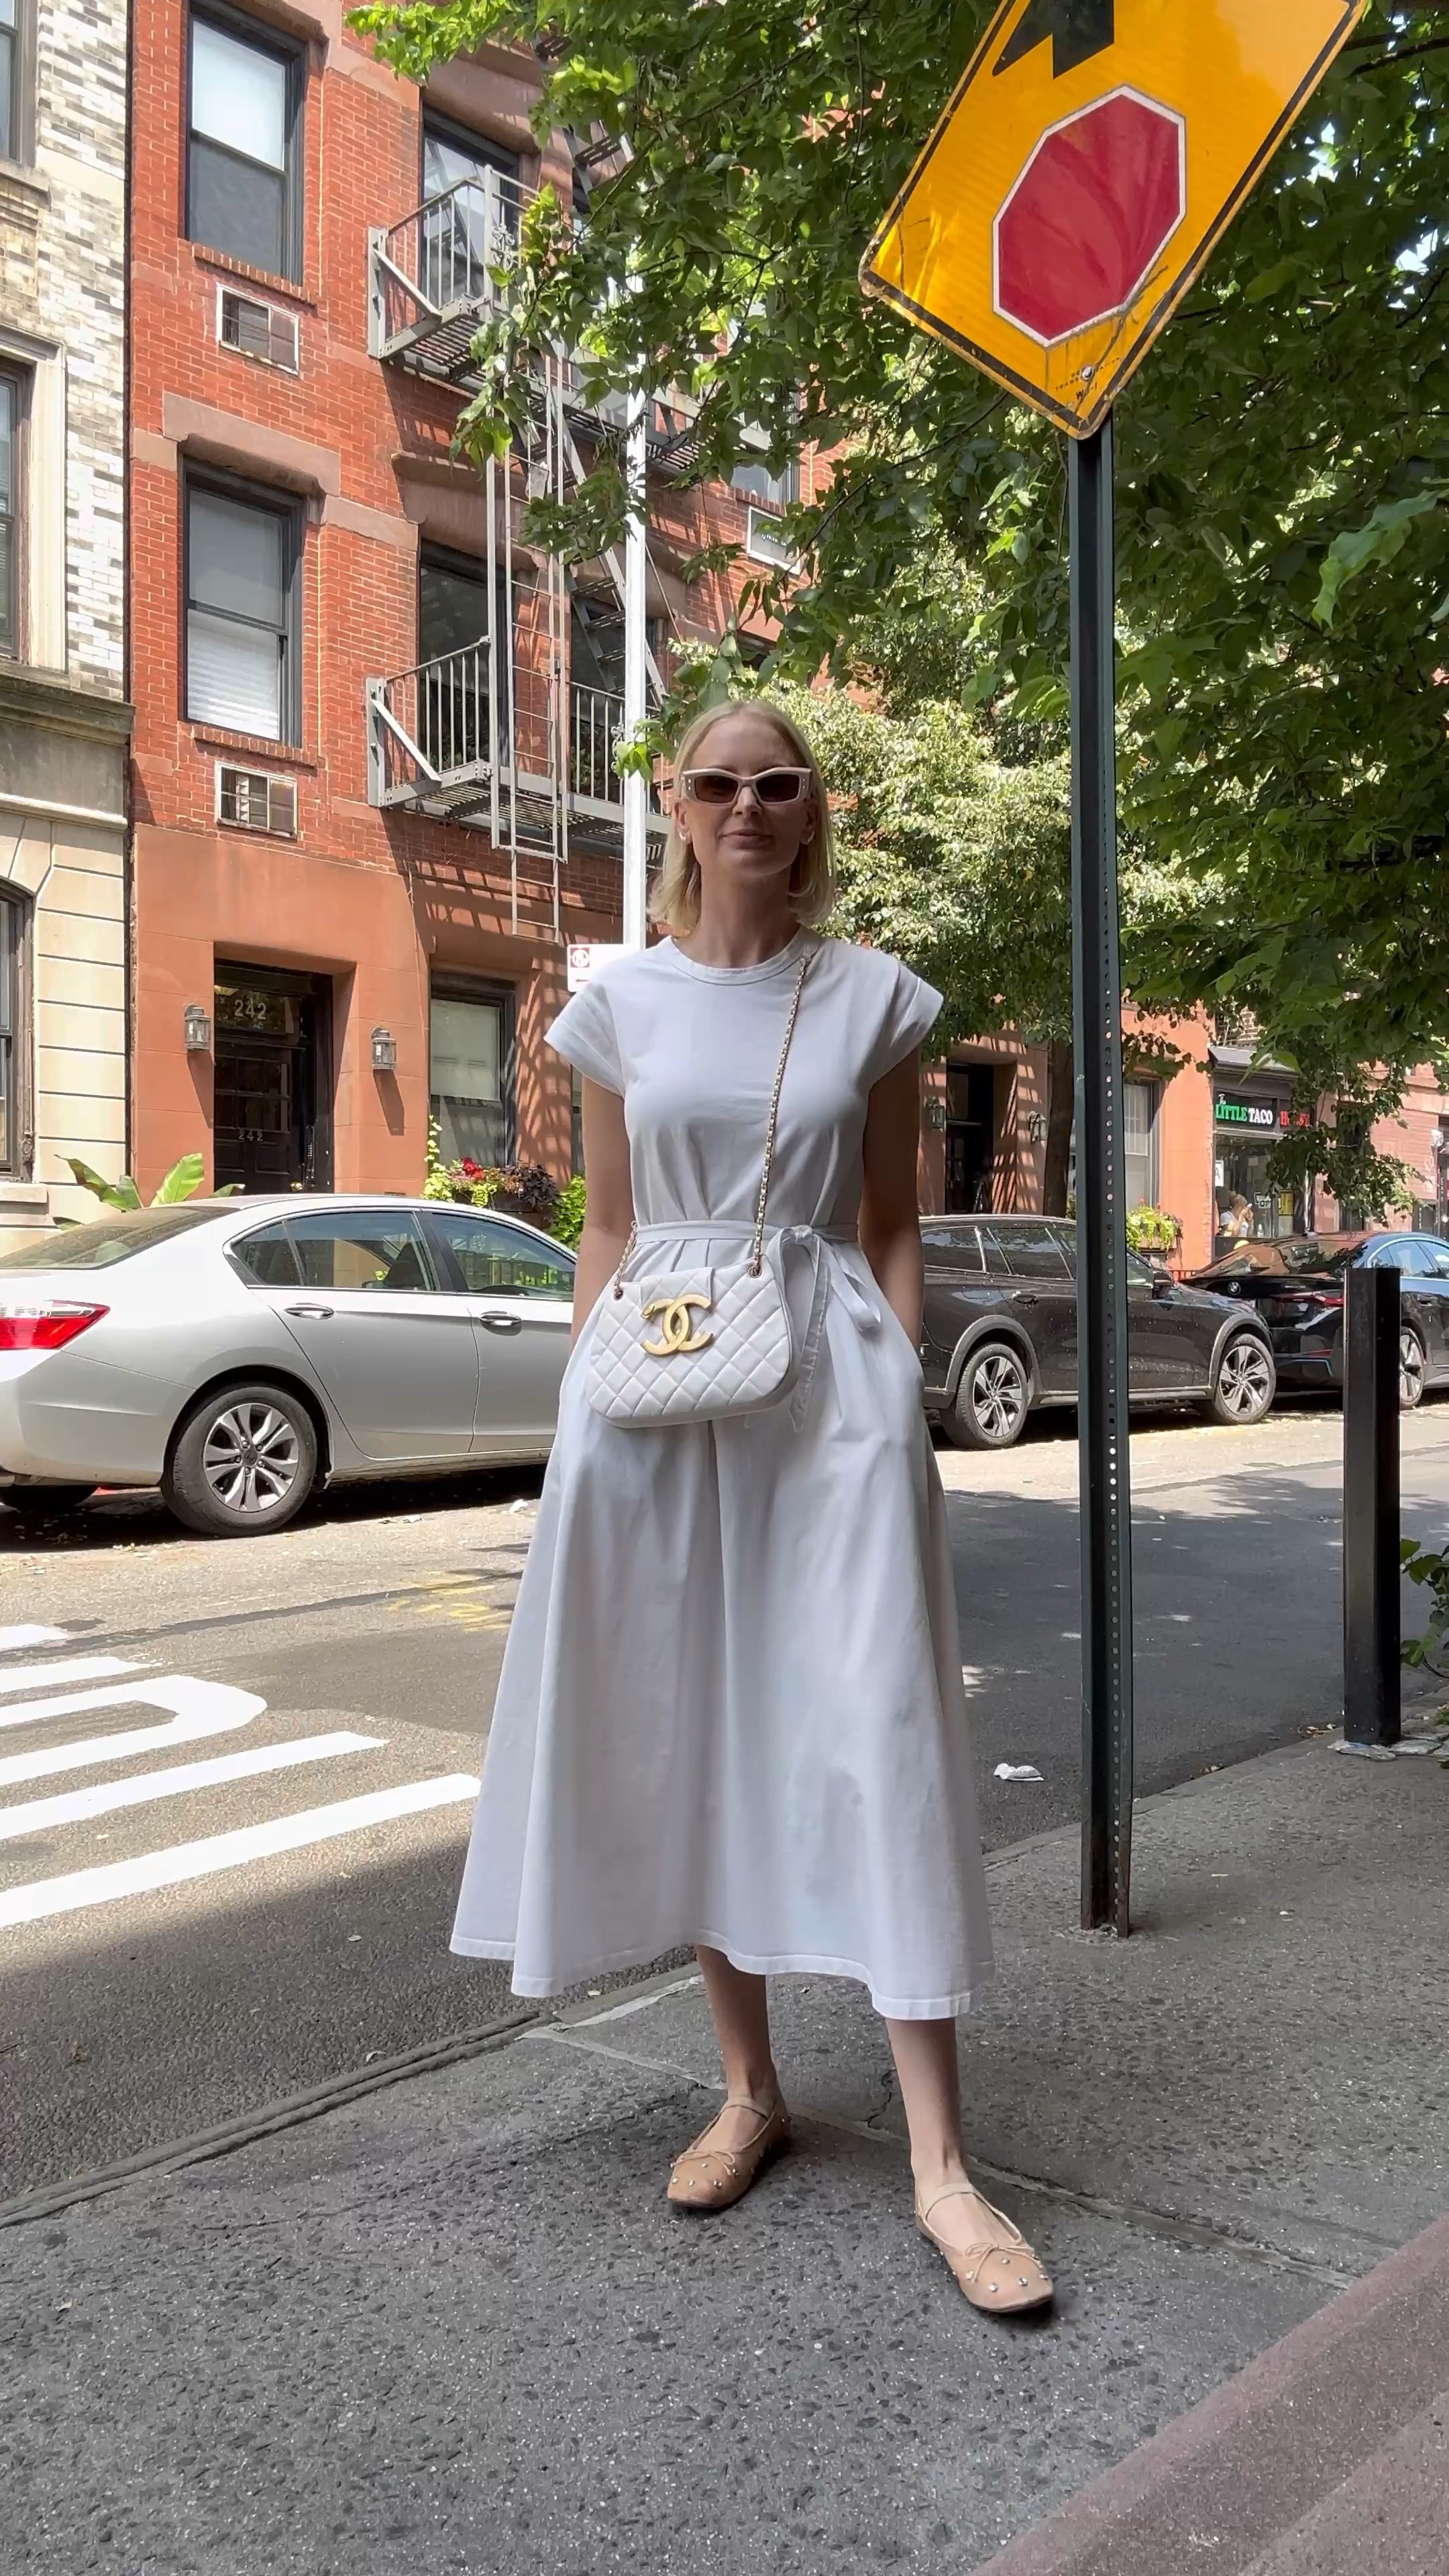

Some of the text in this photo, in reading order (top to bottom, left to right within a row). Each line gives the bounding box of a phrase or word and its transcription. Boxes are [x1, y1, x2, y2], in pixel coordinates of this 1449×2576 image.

[234, 999, 267, 1020] 242
[1215, 1104, 1248, 1122] LITTLE
[1248, 1108, 1273, 1125] TACO
[238, 1130, 264, 1141] 242
